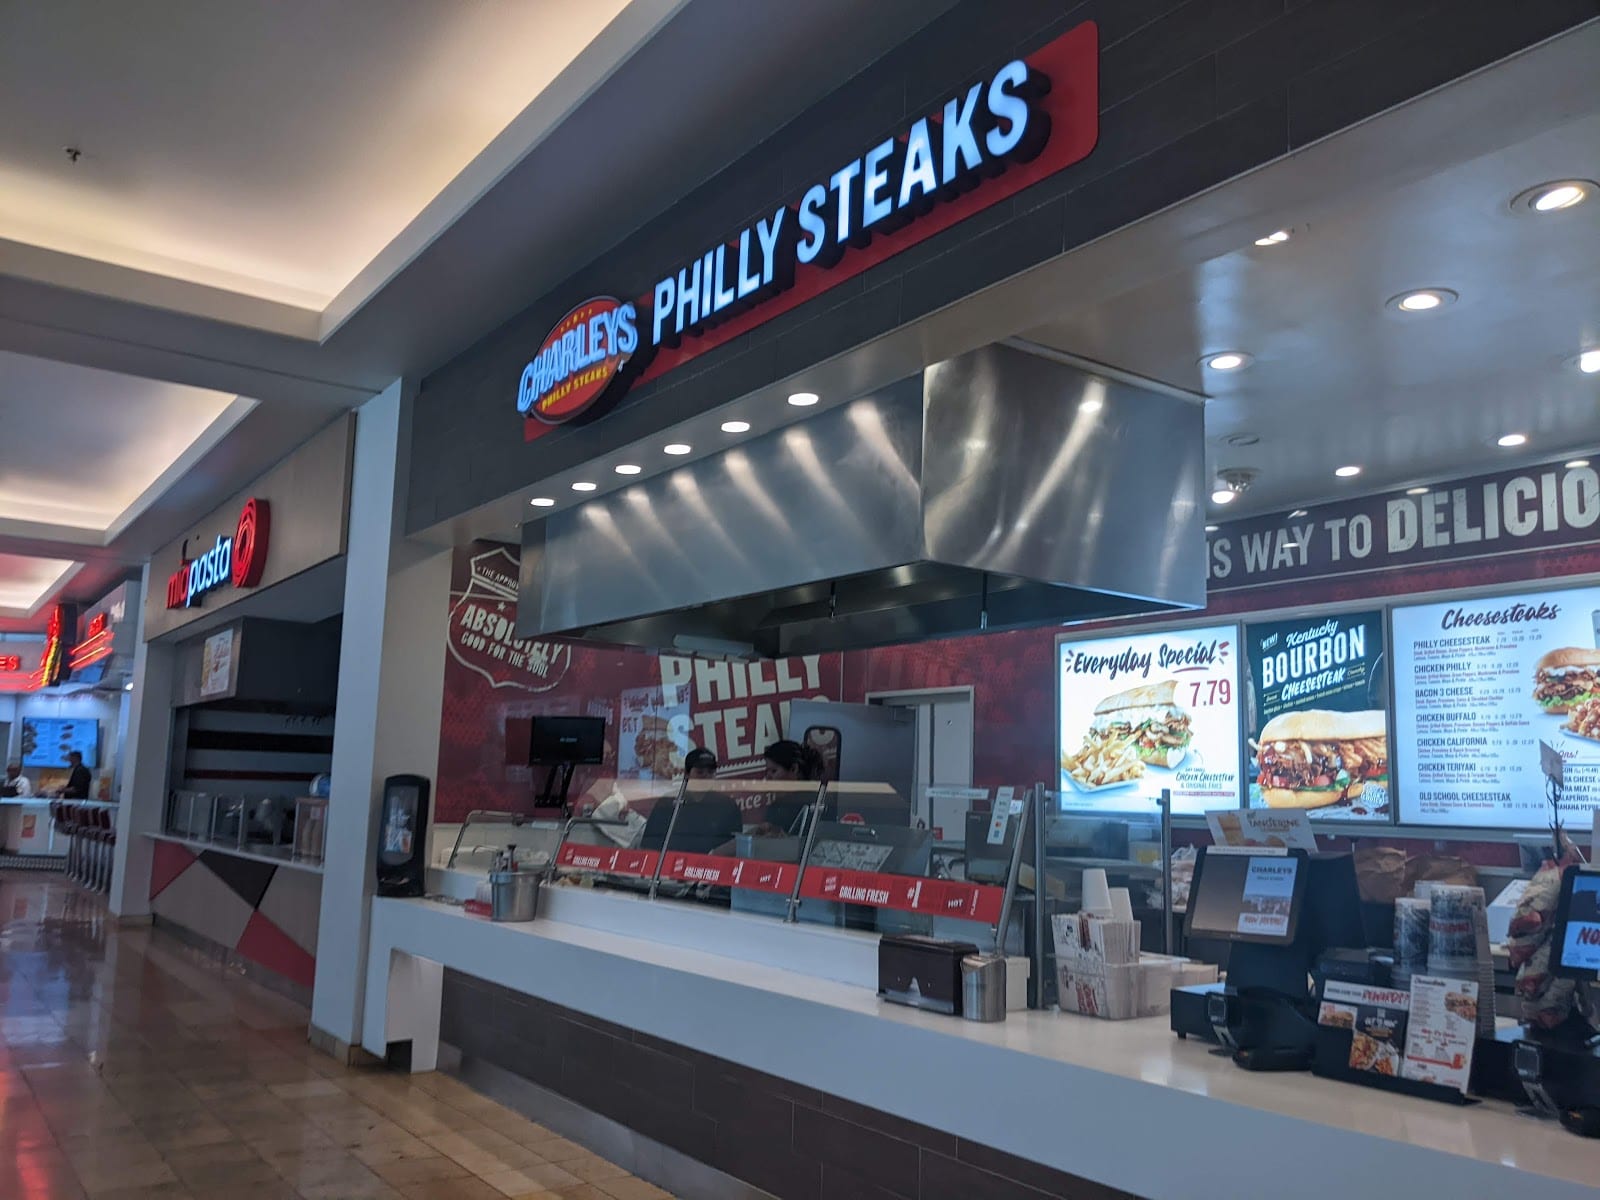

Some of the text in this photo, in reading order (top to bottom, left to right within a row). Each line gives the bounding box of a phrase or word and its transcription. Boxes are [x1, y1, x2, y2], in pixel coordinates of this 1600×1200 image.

[652, 59, 1028, 346] PHILLY STEAKS
[516, 301, 638, 414] CHARLEYS
[541, 365, 609, 411] PHILLY STEAKS
[1242, 523, 1314, 573] WAY
[1324, 514, 1372, 561] TO
[1386, 466, 1600, 553] DELICIO
[481, 566, 495, 580] THE
[1441, 601, 1560, 631] Cheesesteaks
[1262, 632, 1278, 650] NEW!
[1286, 619, 1339, 648] Kentucky
[1413, 639, 1438, 649] PHILLY
[1439, 635, 1491, 648] CHEESESTEAK
[487, 641, 507, 660] FOR
[508, 650, 526, 668] THE
[1073, 639, 1218, 681] Everyday Special
[1262, 623, 1365, 689] BOURBON
[1414, 663, 1445, 674] CHICKEN
[1446, 662, 1471, 672] PHILLY
[659, 654, 822, 705] PHILLY
[1189, 678, 1232, 708] 7.79
[1281, 667, 1346, 701] CHEESESTEAK
[1415, 688, 1438, 698] BACON
[1445, 687, 1474, 696] CHEESE
[1416, 713, 1445, 722] CHICKEN
[1446, 712, 1476, 721] BUFFALO
[667, 694, 829, 776] STEA
[1416, 738, 1446, 747] CHICKEN
[1446, 737, 1488, 746] CALIFORNIA
[1417, 763, 1445, 772] CHICKEN
[1446, 762, 1476, 772] TERIYAKI
[1419, 792, 1512, 801] OLD SCHOOL CHEESESTEAK
[839, 886, 867, 901] GRILLING
[865, 888, 890, 905] FRESH
[906, 880, 923, 908] #1
